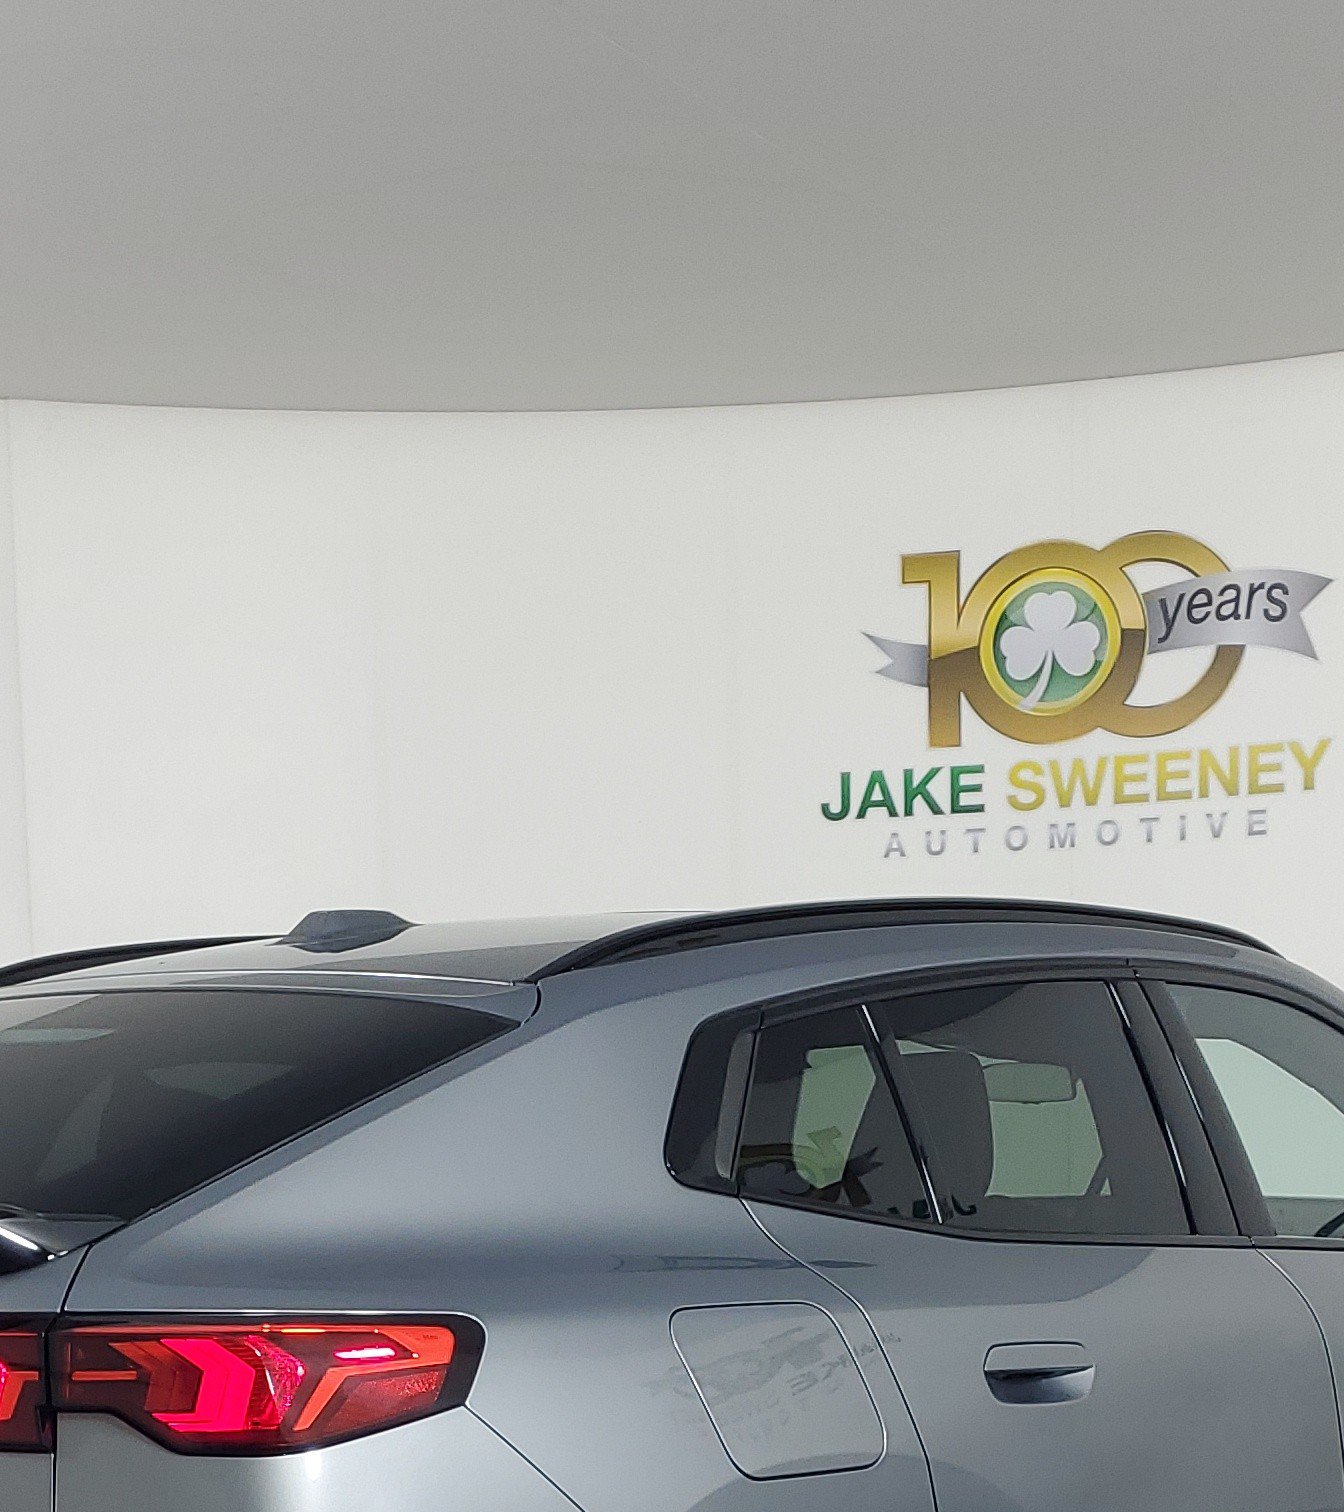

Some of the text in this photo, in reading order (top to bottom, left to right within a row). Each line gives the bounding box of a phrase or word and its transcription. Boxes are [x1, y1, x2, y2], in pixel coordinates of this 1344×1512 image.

[900, 529, 1290, 748] 100 years
[820, 737, 1333, 822] JAKE SWEENEY
[882, 808, 1270, 859] AUTOMOTIVE
